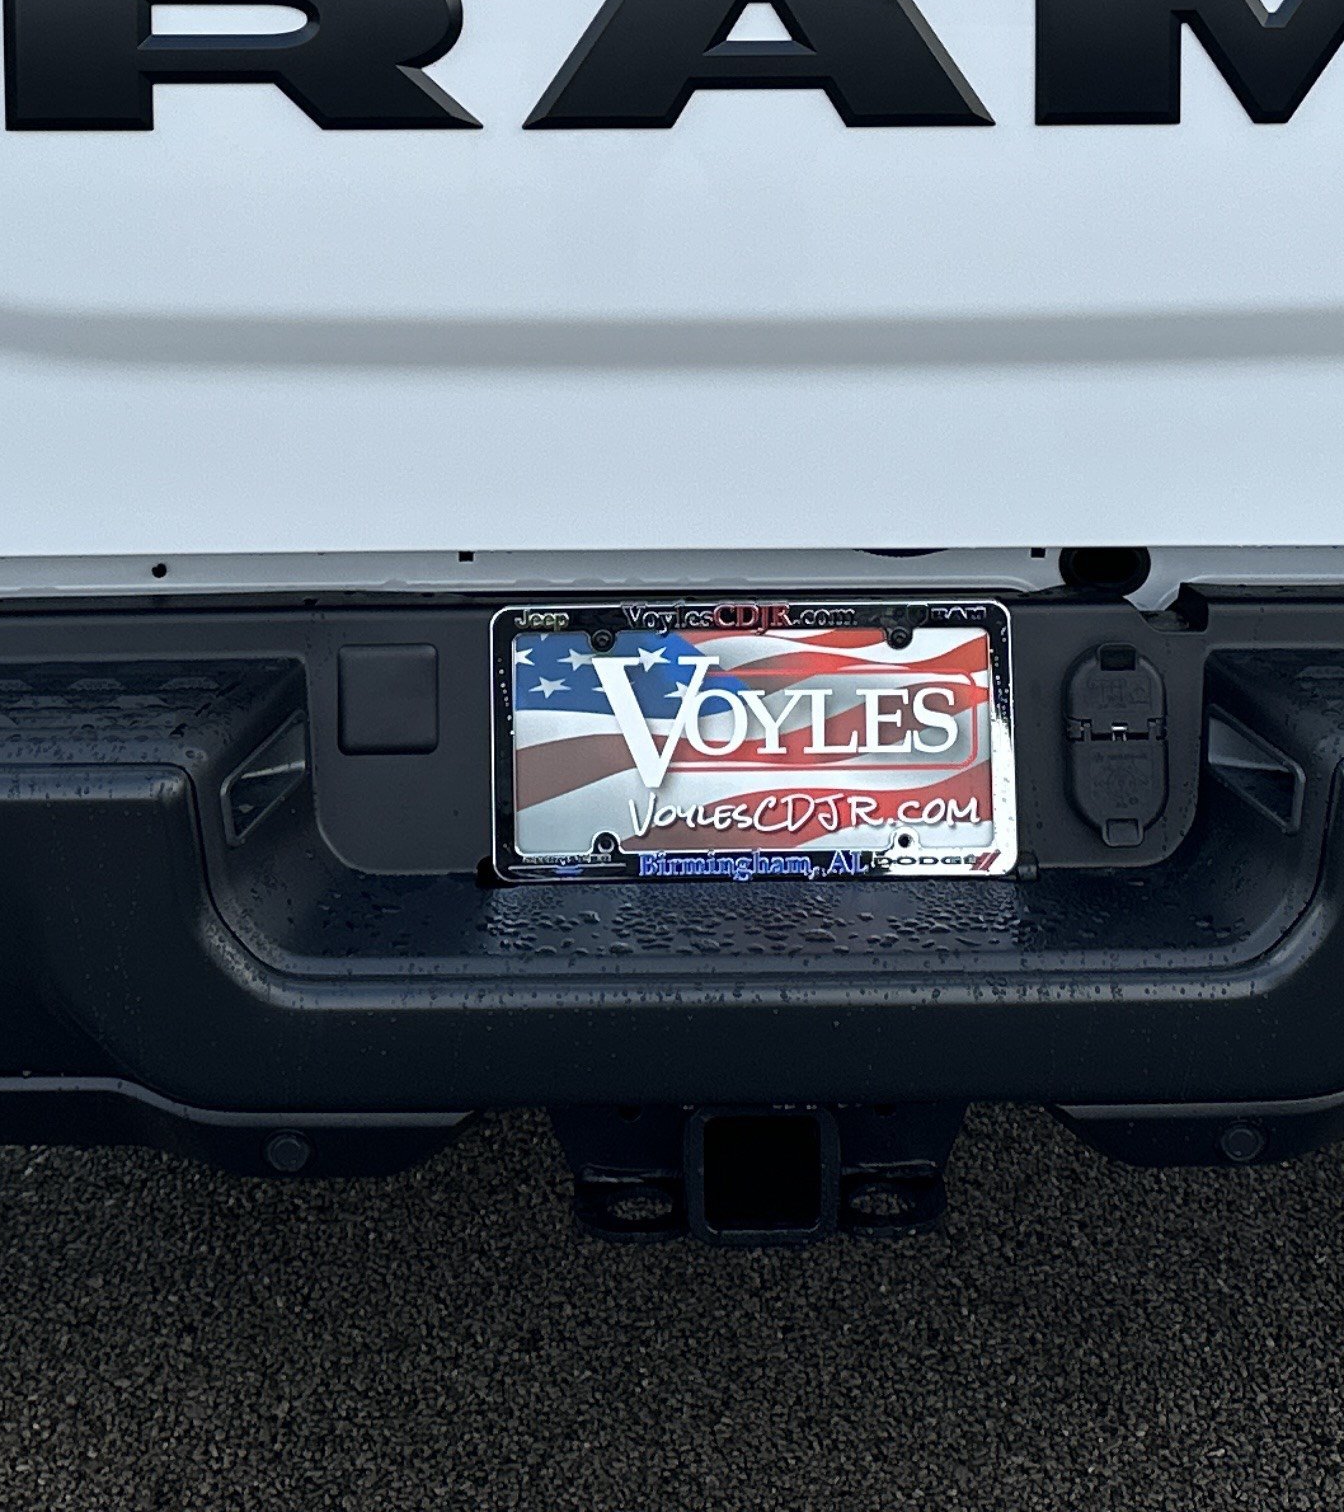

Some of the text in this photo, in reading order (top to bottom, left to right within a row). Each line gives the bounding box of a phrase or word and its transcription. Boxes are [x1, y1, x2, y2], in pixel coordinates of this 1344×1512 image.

[514, 609, 570, 631] Jeep
[621, 600, 857, 636] VoylesCDJR.com
[930, 606, 986, 620] RAM
[592, 655, 958, 789] VOYLES
[638, 849, 820, 882] Birmingham,
[826, 850, 869, 876] AL
[873, 853, 977, 868] DODGE
